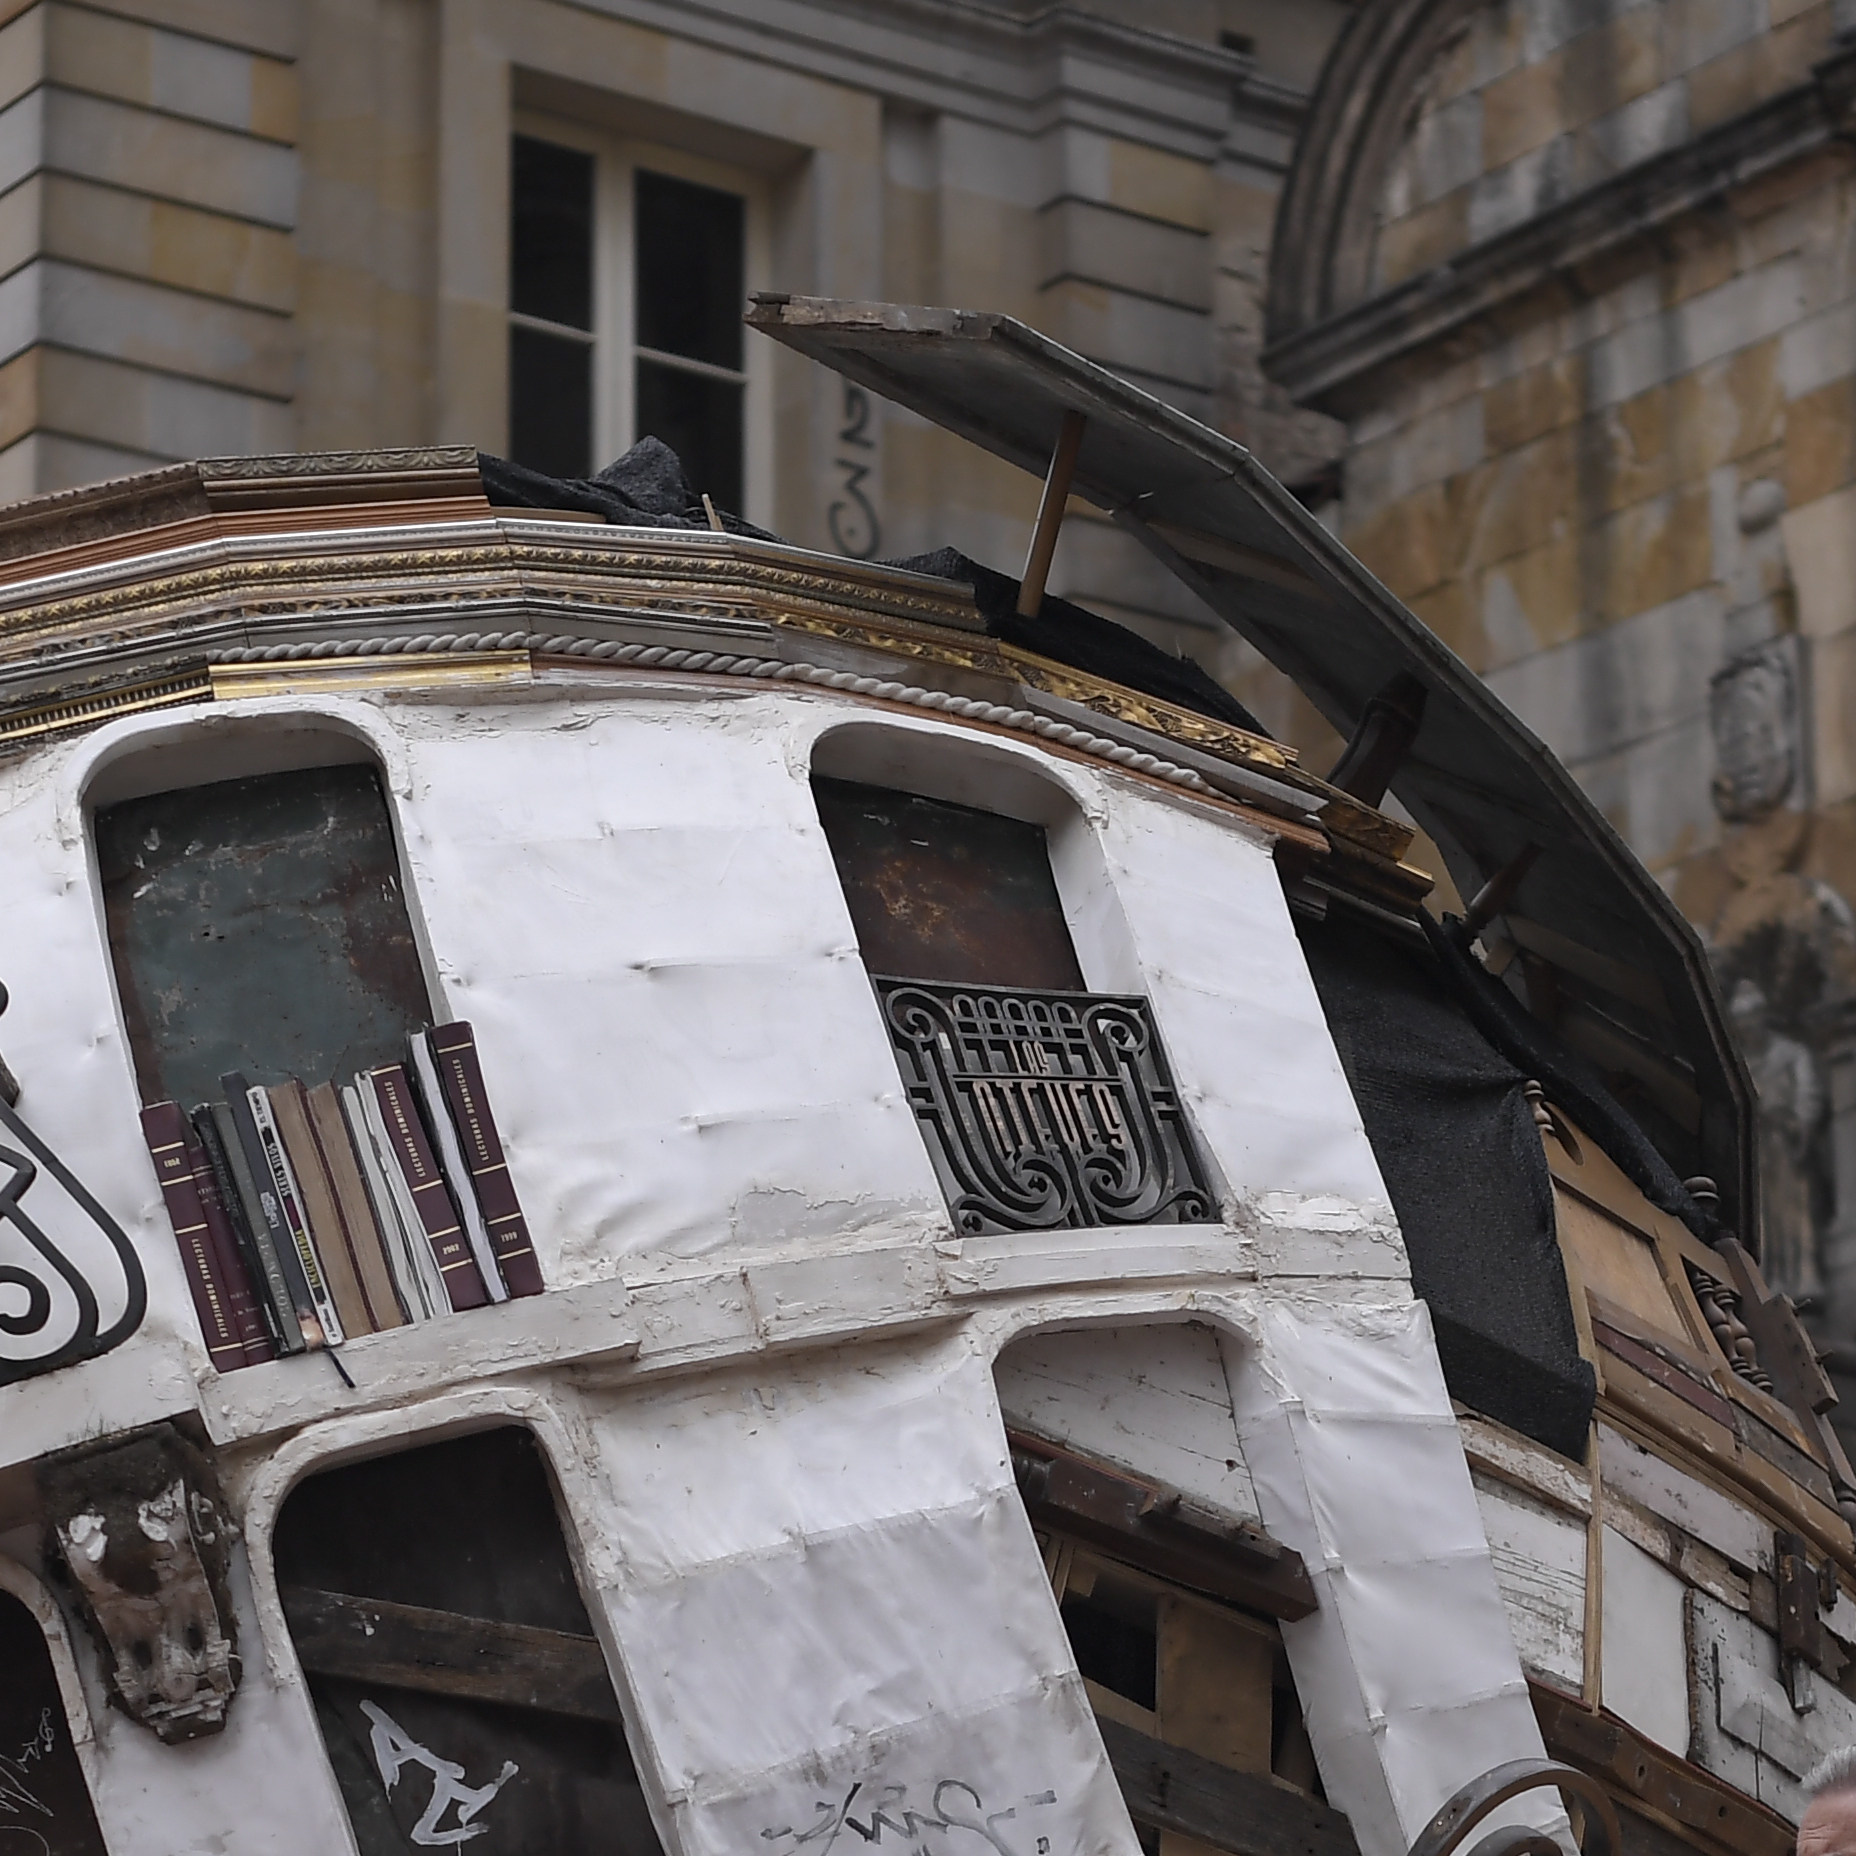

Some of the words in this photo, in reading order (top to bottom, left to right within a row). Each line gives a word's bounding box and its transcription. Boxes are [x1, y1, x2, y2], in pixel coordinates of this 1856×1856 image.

[383, 1081, 410, 1136] DOMINICALES
[451, 1058, 477, 1117] DOMINICALES
[266, 1142, 283, 1169] VIVOS
[403, 1137, 427, 1178] LECTURAS
[469, 1118, 490, 1161] LECTURAS
[276, 1168, 291, 1197] SERES
[294, 1228, 323, 1289] ENCICLOPEDIA
[190, 1238, 211, 1281] LECTURAS
[205, 1281, 229, 1338] DOMINICALES
